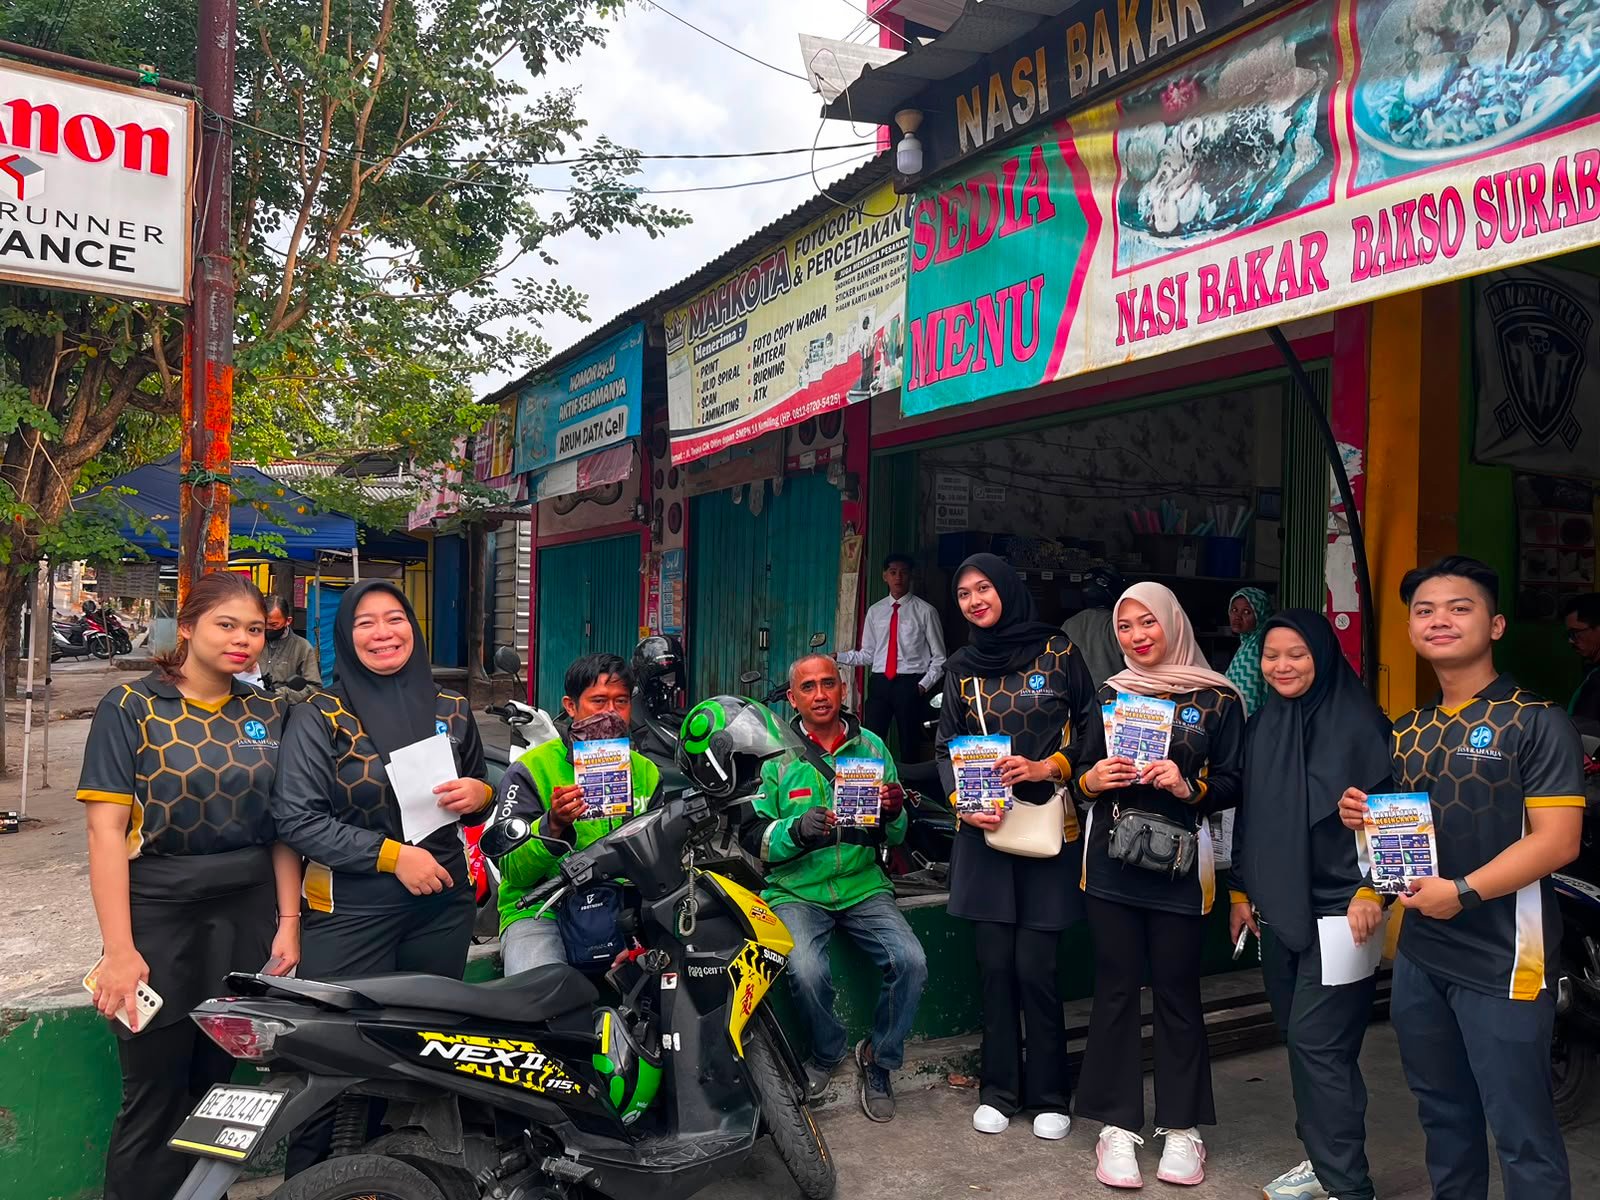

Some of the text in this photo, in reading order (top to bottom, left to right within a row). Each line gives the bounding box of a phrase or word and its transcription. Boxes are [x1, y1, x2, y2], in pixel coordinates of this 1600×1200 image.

[956, 46, 1049, 154] NASI
[0, 98, 170, 177] non
[911, 144, 1056, 274] SEDIA
[794, 199, 866, 261] FOTOCOPY
[806, 207, 902, 280] PERCETAKAN
[0, 227, 136, 273] ANCE
[1115, 148, 1600, 347] NASI BAKAR BAKSO SURAB
[857, 263, 880, 282] BANNER
[687, 246, 792, 343] MAHKOTA
[835, 286, 856, 304] STICKER
[851, 291, 868, 307] KARTU
[867, 286, 884, 299] NAMA
[753, 304, 828, 353] FOTO COPY WARNA
[907, 273, 1044, 393] MENU
[695, 330, 737, 361] Menerima
[753, 342, 787, 370] MATERAI
[700, 358, 719, 379] PRINT
[717, 364, 741, 386] SPIRAL
[753, 360, 785, 386] BURNING
[578, 377, 627, 412] SELAMANYA
[701, 391, 718, 409] SCAN
[753, 385, 769, 404] ATK
[701, 397, 740, 424] LAMINATING
[559, 412, 625, 454] ARUM DATA Cell
[420, 1040, 525, 1067] NEX
[546, 1079, 574, 1090] 115
[200, 1092, 226, 1115] BE
